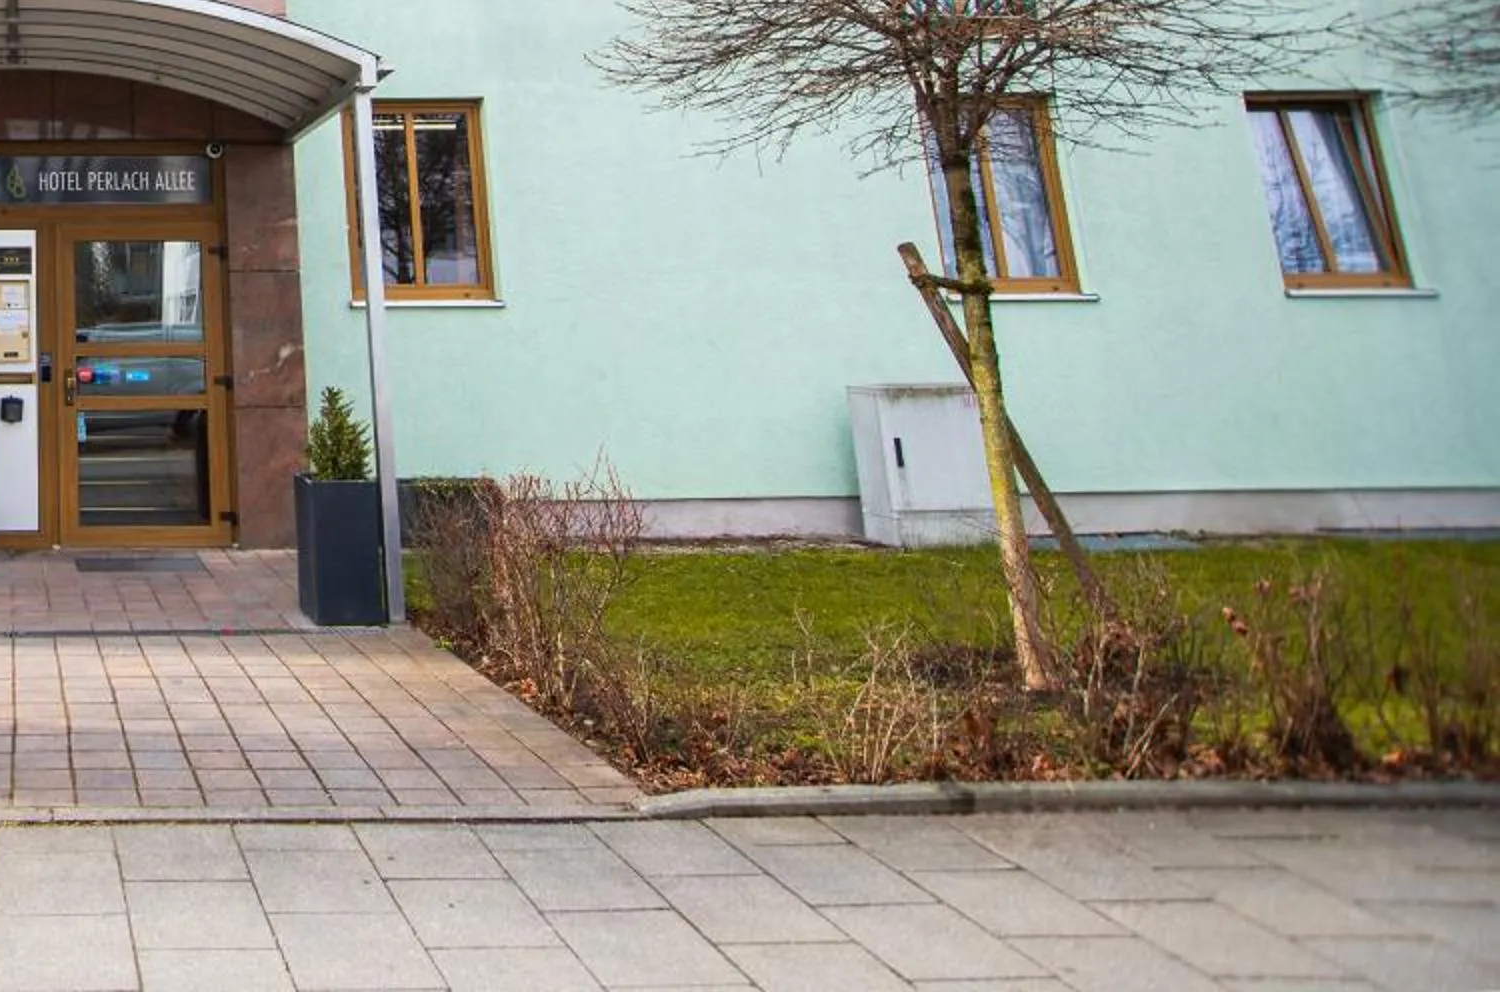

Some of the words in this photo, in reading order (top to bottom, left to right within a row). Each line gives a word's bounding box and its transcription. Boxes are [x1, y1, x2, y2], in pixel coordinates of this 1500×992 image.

[38, 171, 83, 192] HOTEL
[87, 171, 150, 192] PERLACH
[155, 171, 196, 192] ALLEE
